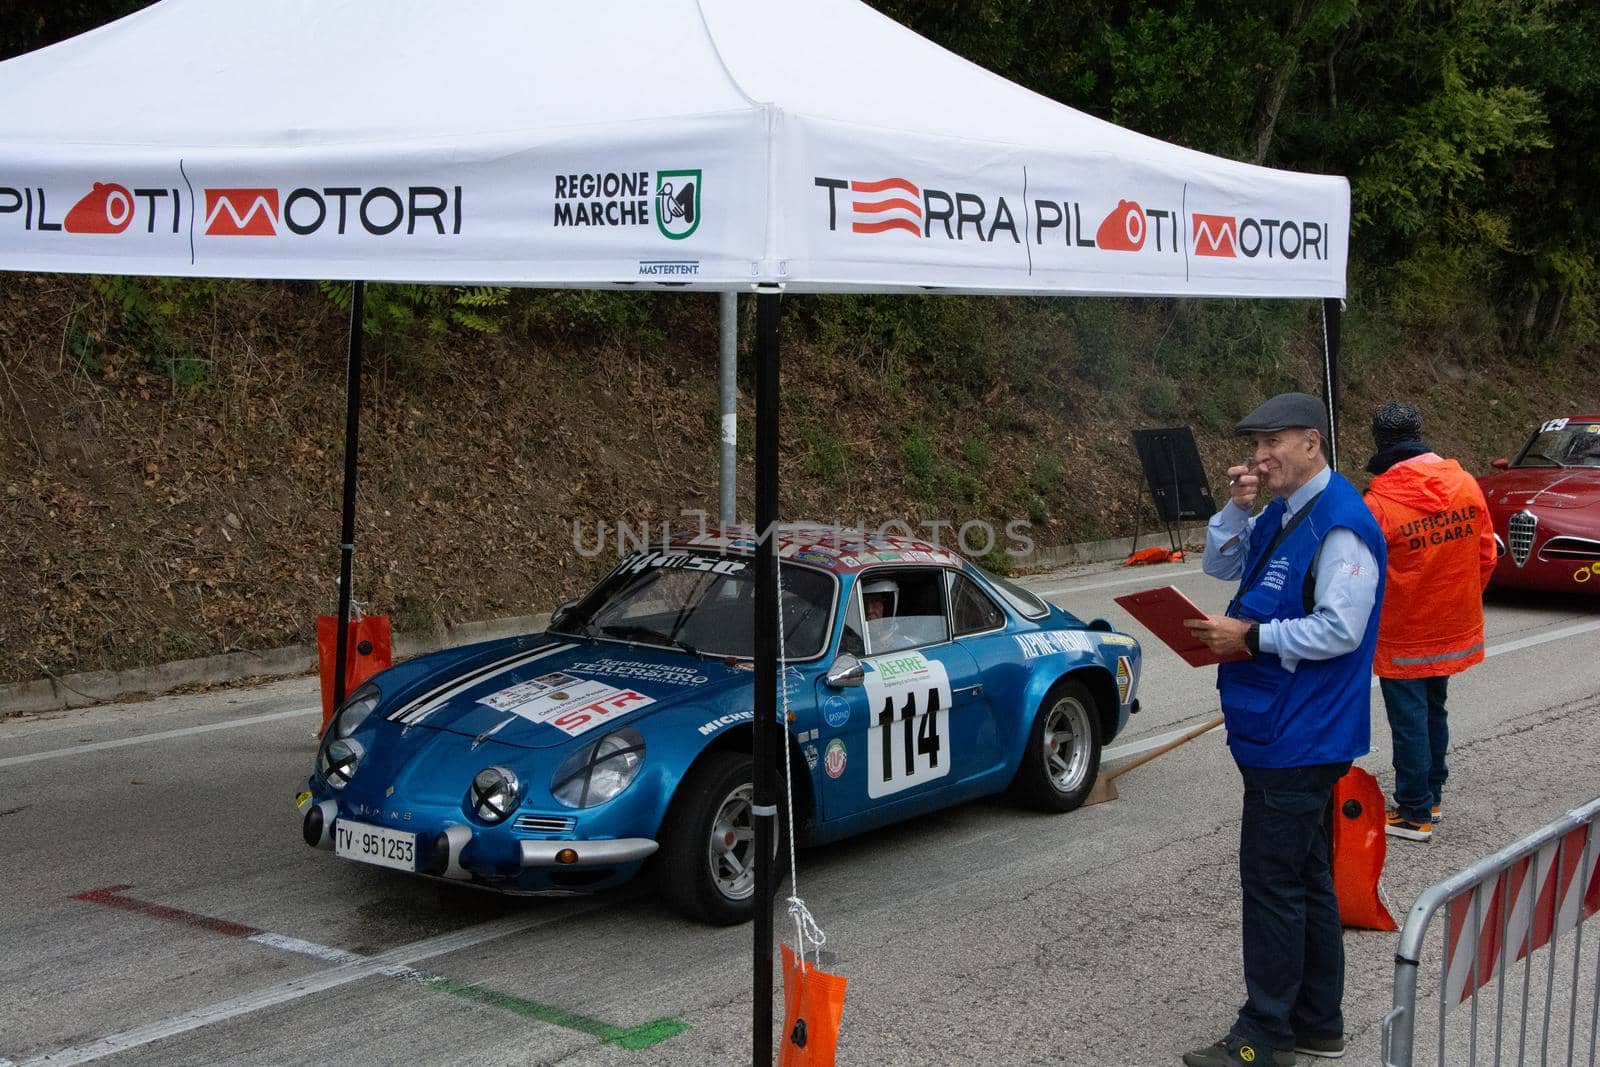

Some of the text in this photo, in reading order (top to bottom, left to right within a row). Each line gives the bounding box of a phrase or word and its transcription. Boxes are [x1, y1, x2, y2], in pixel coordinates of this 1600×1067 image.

[555, 172, 649, 199] REGIONE
[205, 187, 462, 236] MOTORI
[554, 200, 649, 227] MARCHE
[1036, 199, 1177, 252] PILOTI
[1193, 213, 1328, 260] MOTORI
[638, 264, 699, 275] MASTERTENT
[1400, 506, 1476, 537] UFFICIALE
[1409, 524, 1474, 550] DI GARA
[880, 656, 926, 677] AERRE
[554, 690, 646, 731] STR
[698, 710, 754, 736] MICHE
[878, 687, 941, 783] 114
[337, 828, 413, 862] TV 951253
